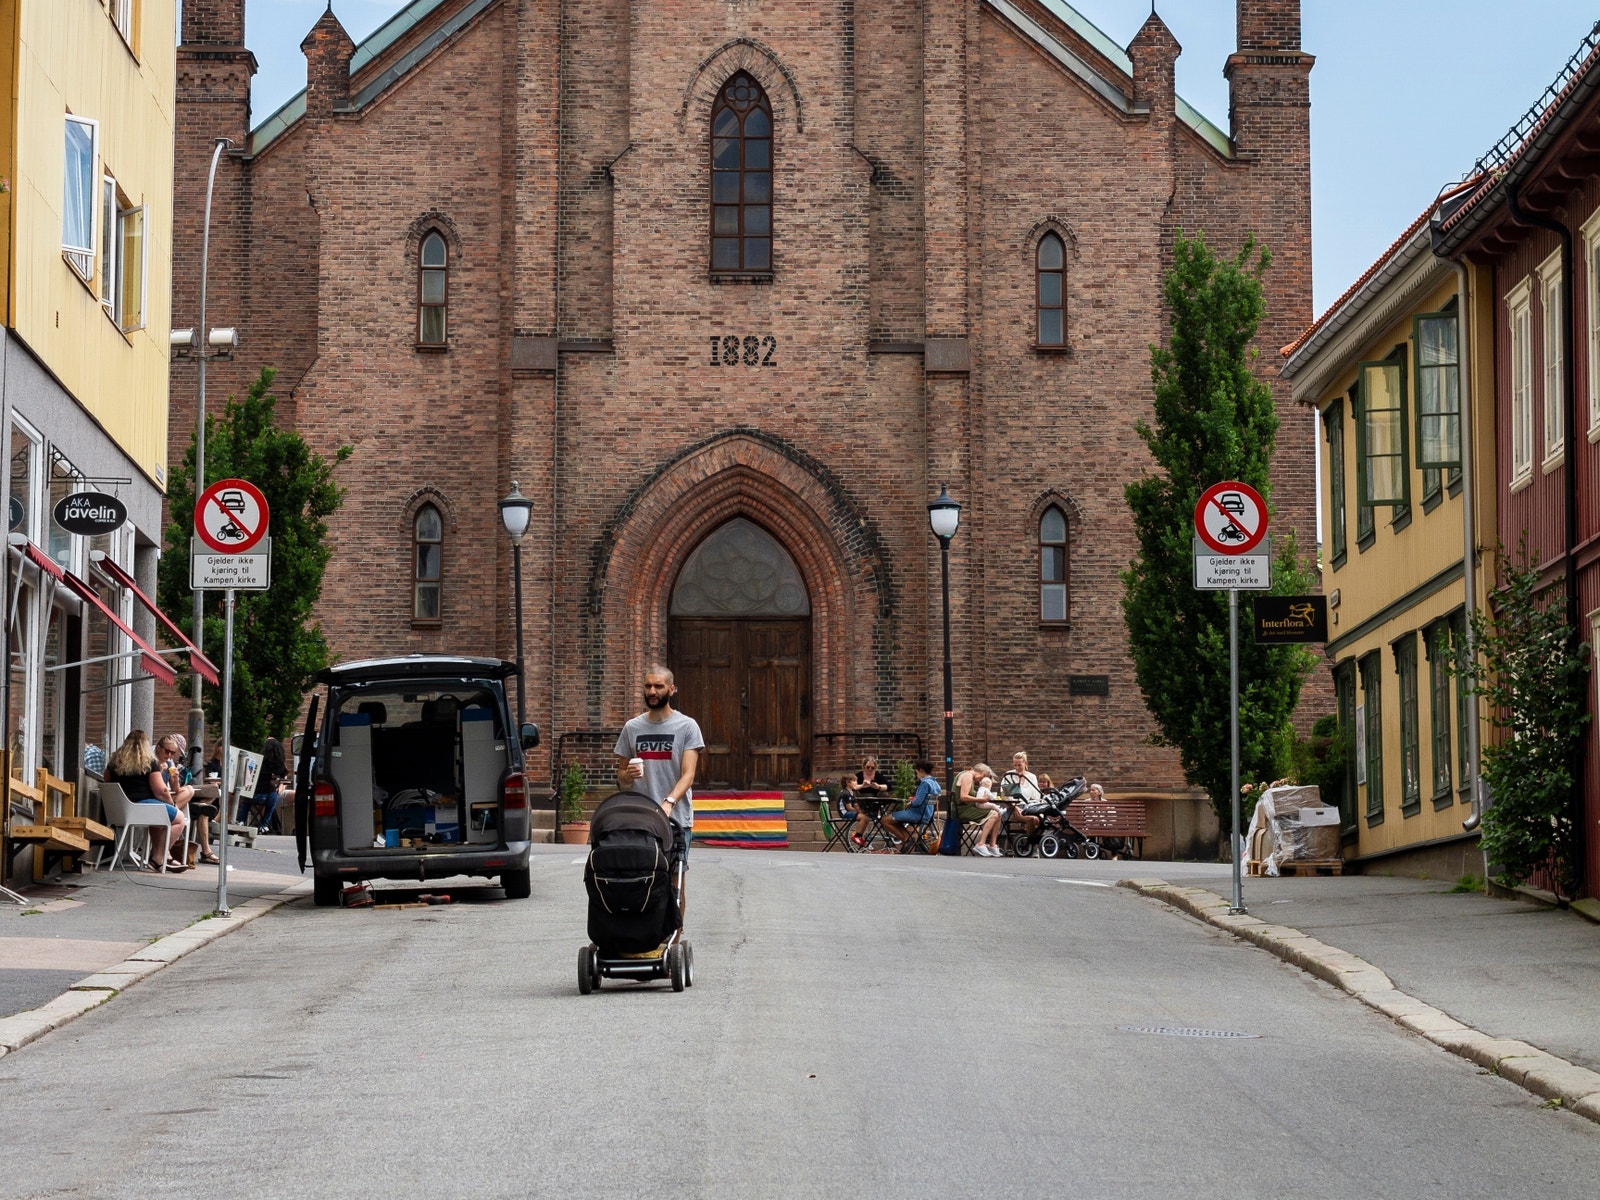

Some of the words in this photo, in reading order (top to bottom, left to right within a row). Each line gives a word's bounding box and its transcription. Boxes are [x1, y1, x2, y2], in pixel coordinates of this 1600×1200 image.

[709, 335, 777, 366] 1882
[70, 498, 91, 507] AKA
[64, 505, 116, 521] javelin
[207, 557, 234, 566] Gjelder
[1210, 558, 1236, 566] Gjelder
[212, 567, 237, 575] kjøring
[1214, 568, 1240, 576] kjøring
[204, 576, 234, 584] Kampen
[1262, 618, 1304, 628] Interflora
